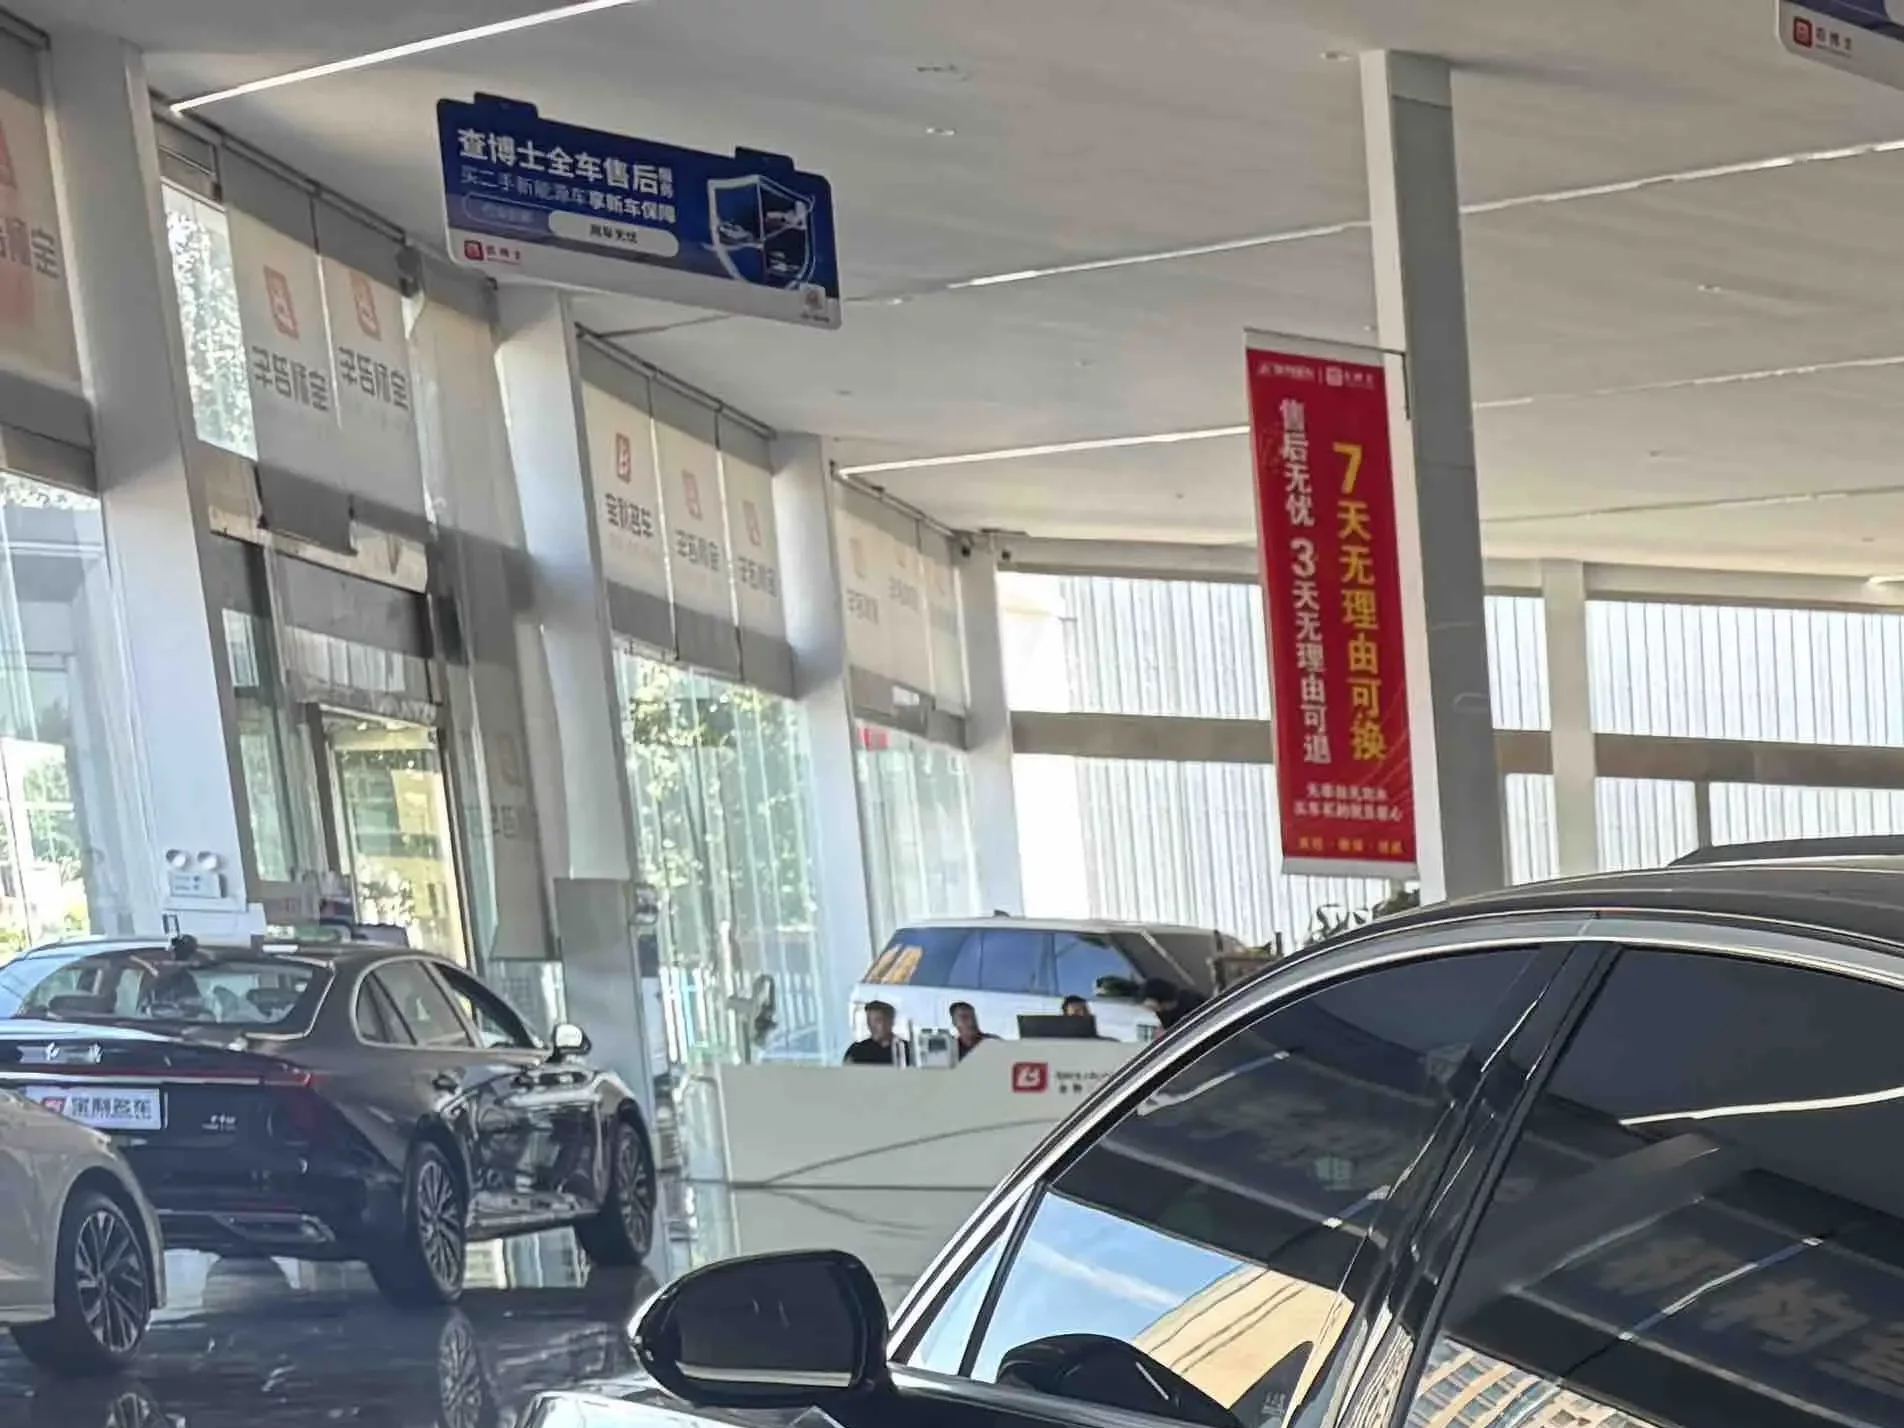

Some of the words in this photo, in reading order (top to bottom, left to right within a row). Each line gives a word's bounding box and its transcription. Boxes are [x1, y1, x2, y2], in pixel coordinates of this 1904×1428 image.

[1332, 441, 1388, 761] 7天无理由可换
